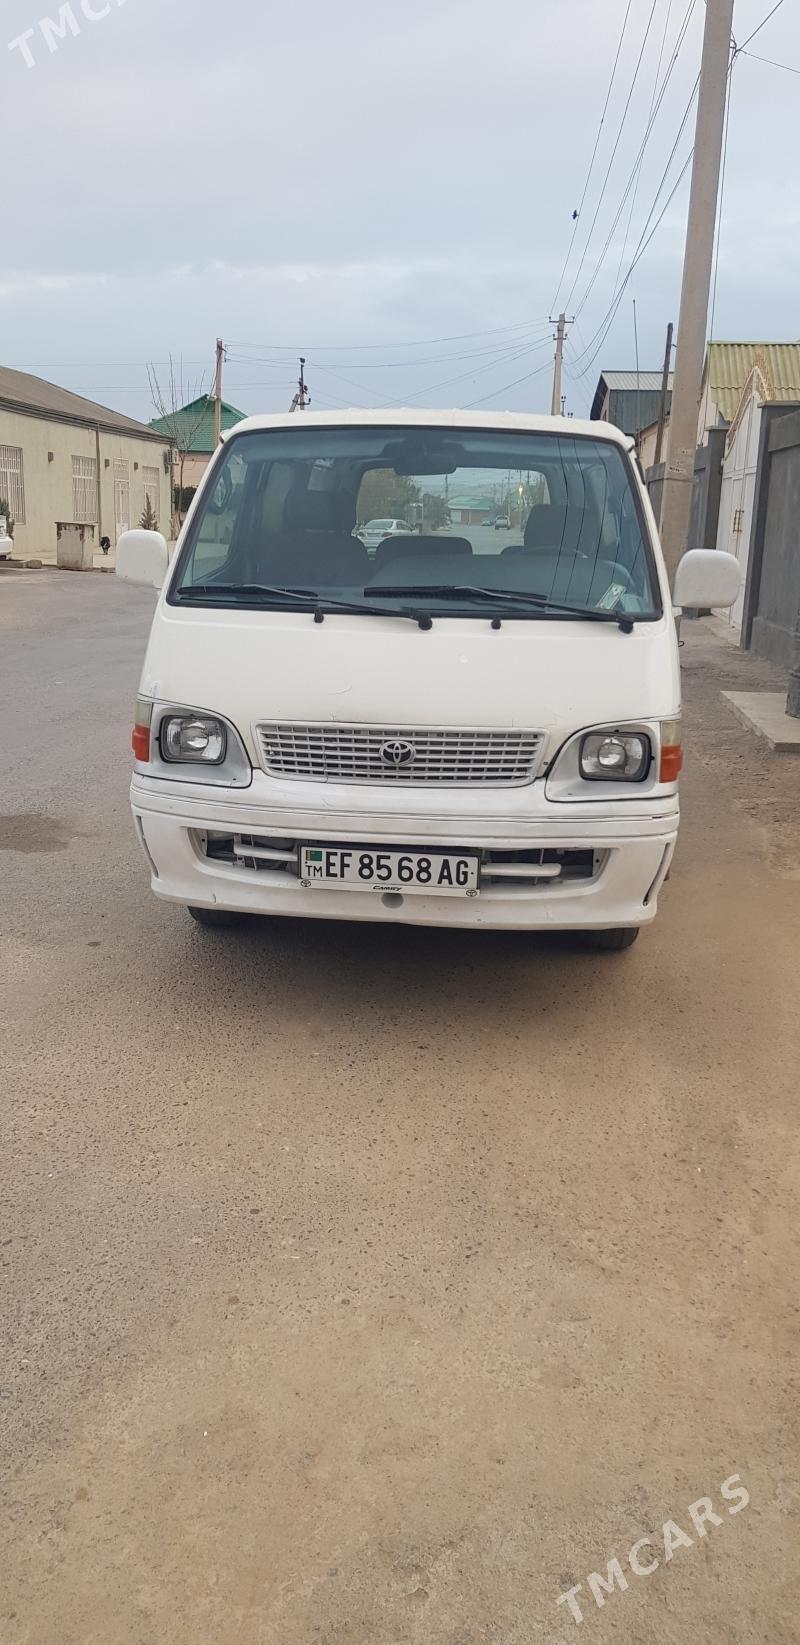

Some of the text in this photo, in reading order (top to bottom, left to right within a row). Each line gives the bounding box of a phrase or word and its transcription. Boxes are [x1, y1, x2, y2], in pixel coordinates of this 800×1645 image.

[305, 864, 323, 878] TM
[325, 852, 352, 878] EF
[437, 859, 469, 886] AG
